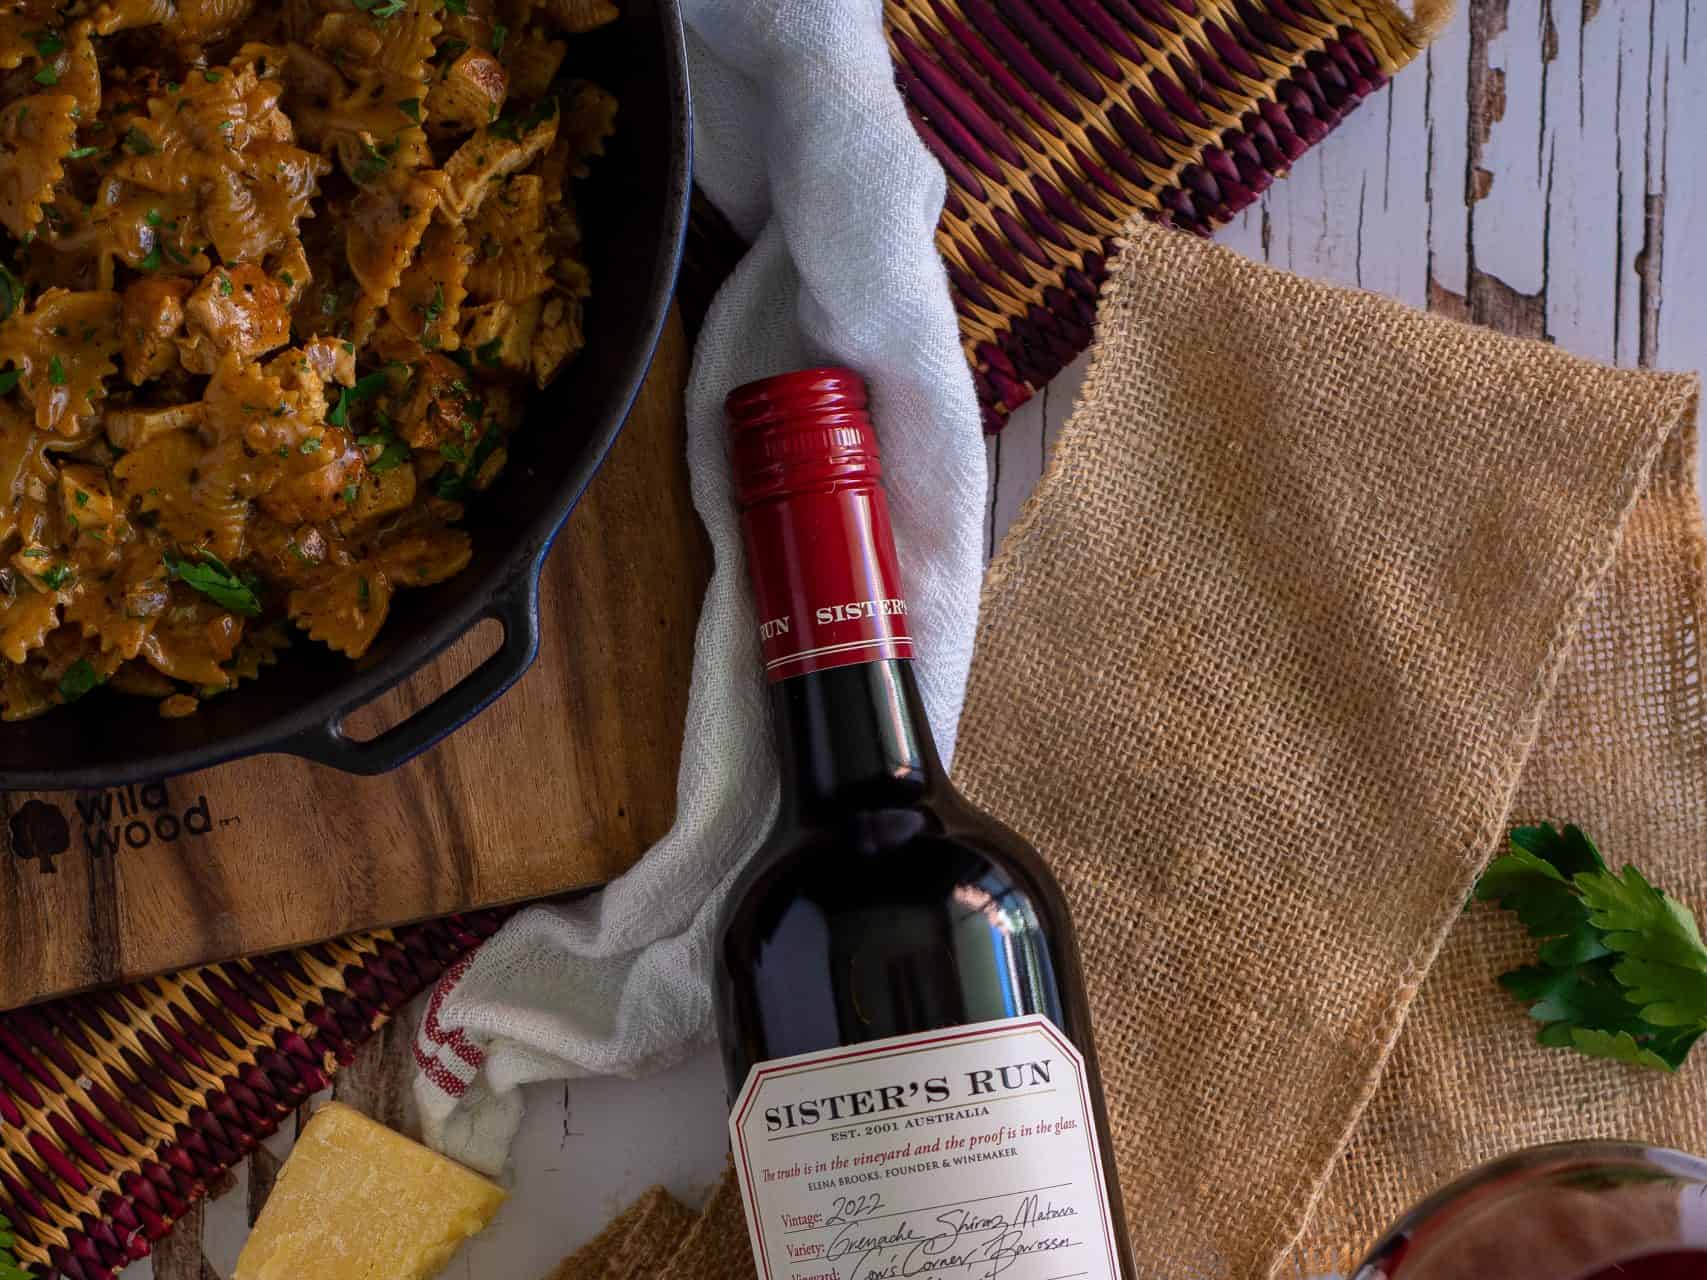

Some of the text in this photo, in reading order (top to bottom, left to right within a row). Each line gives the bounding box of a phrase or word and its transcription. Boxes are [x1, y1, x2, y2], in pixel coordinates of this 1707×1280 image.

[816, 599, 908, 625] SISTER'
[75, 777, 168, 825] wild
[84, 795, 212, 857] wood
[965, 1059, 1052, 1097] RUN
[831, 1106, 990, 1143] EST. 2001 AUSTRALIA
[762, 1116, 1077, 1182] The truth is in the vineyard and the proof is in the glass.
[808, 1180, 836, 1192] ELENA
[885, 1161, 940, 1178] FOUNDER
[943, 1160, 950, 1168] &
[953, 1148, 1018, 1165] WINEMAKER
[781, 1193, 885, 1229] Vintage: 2022
[785, 1243, 825, 1258] Variety:
[826, 1222, 925, 1262] Grenache
